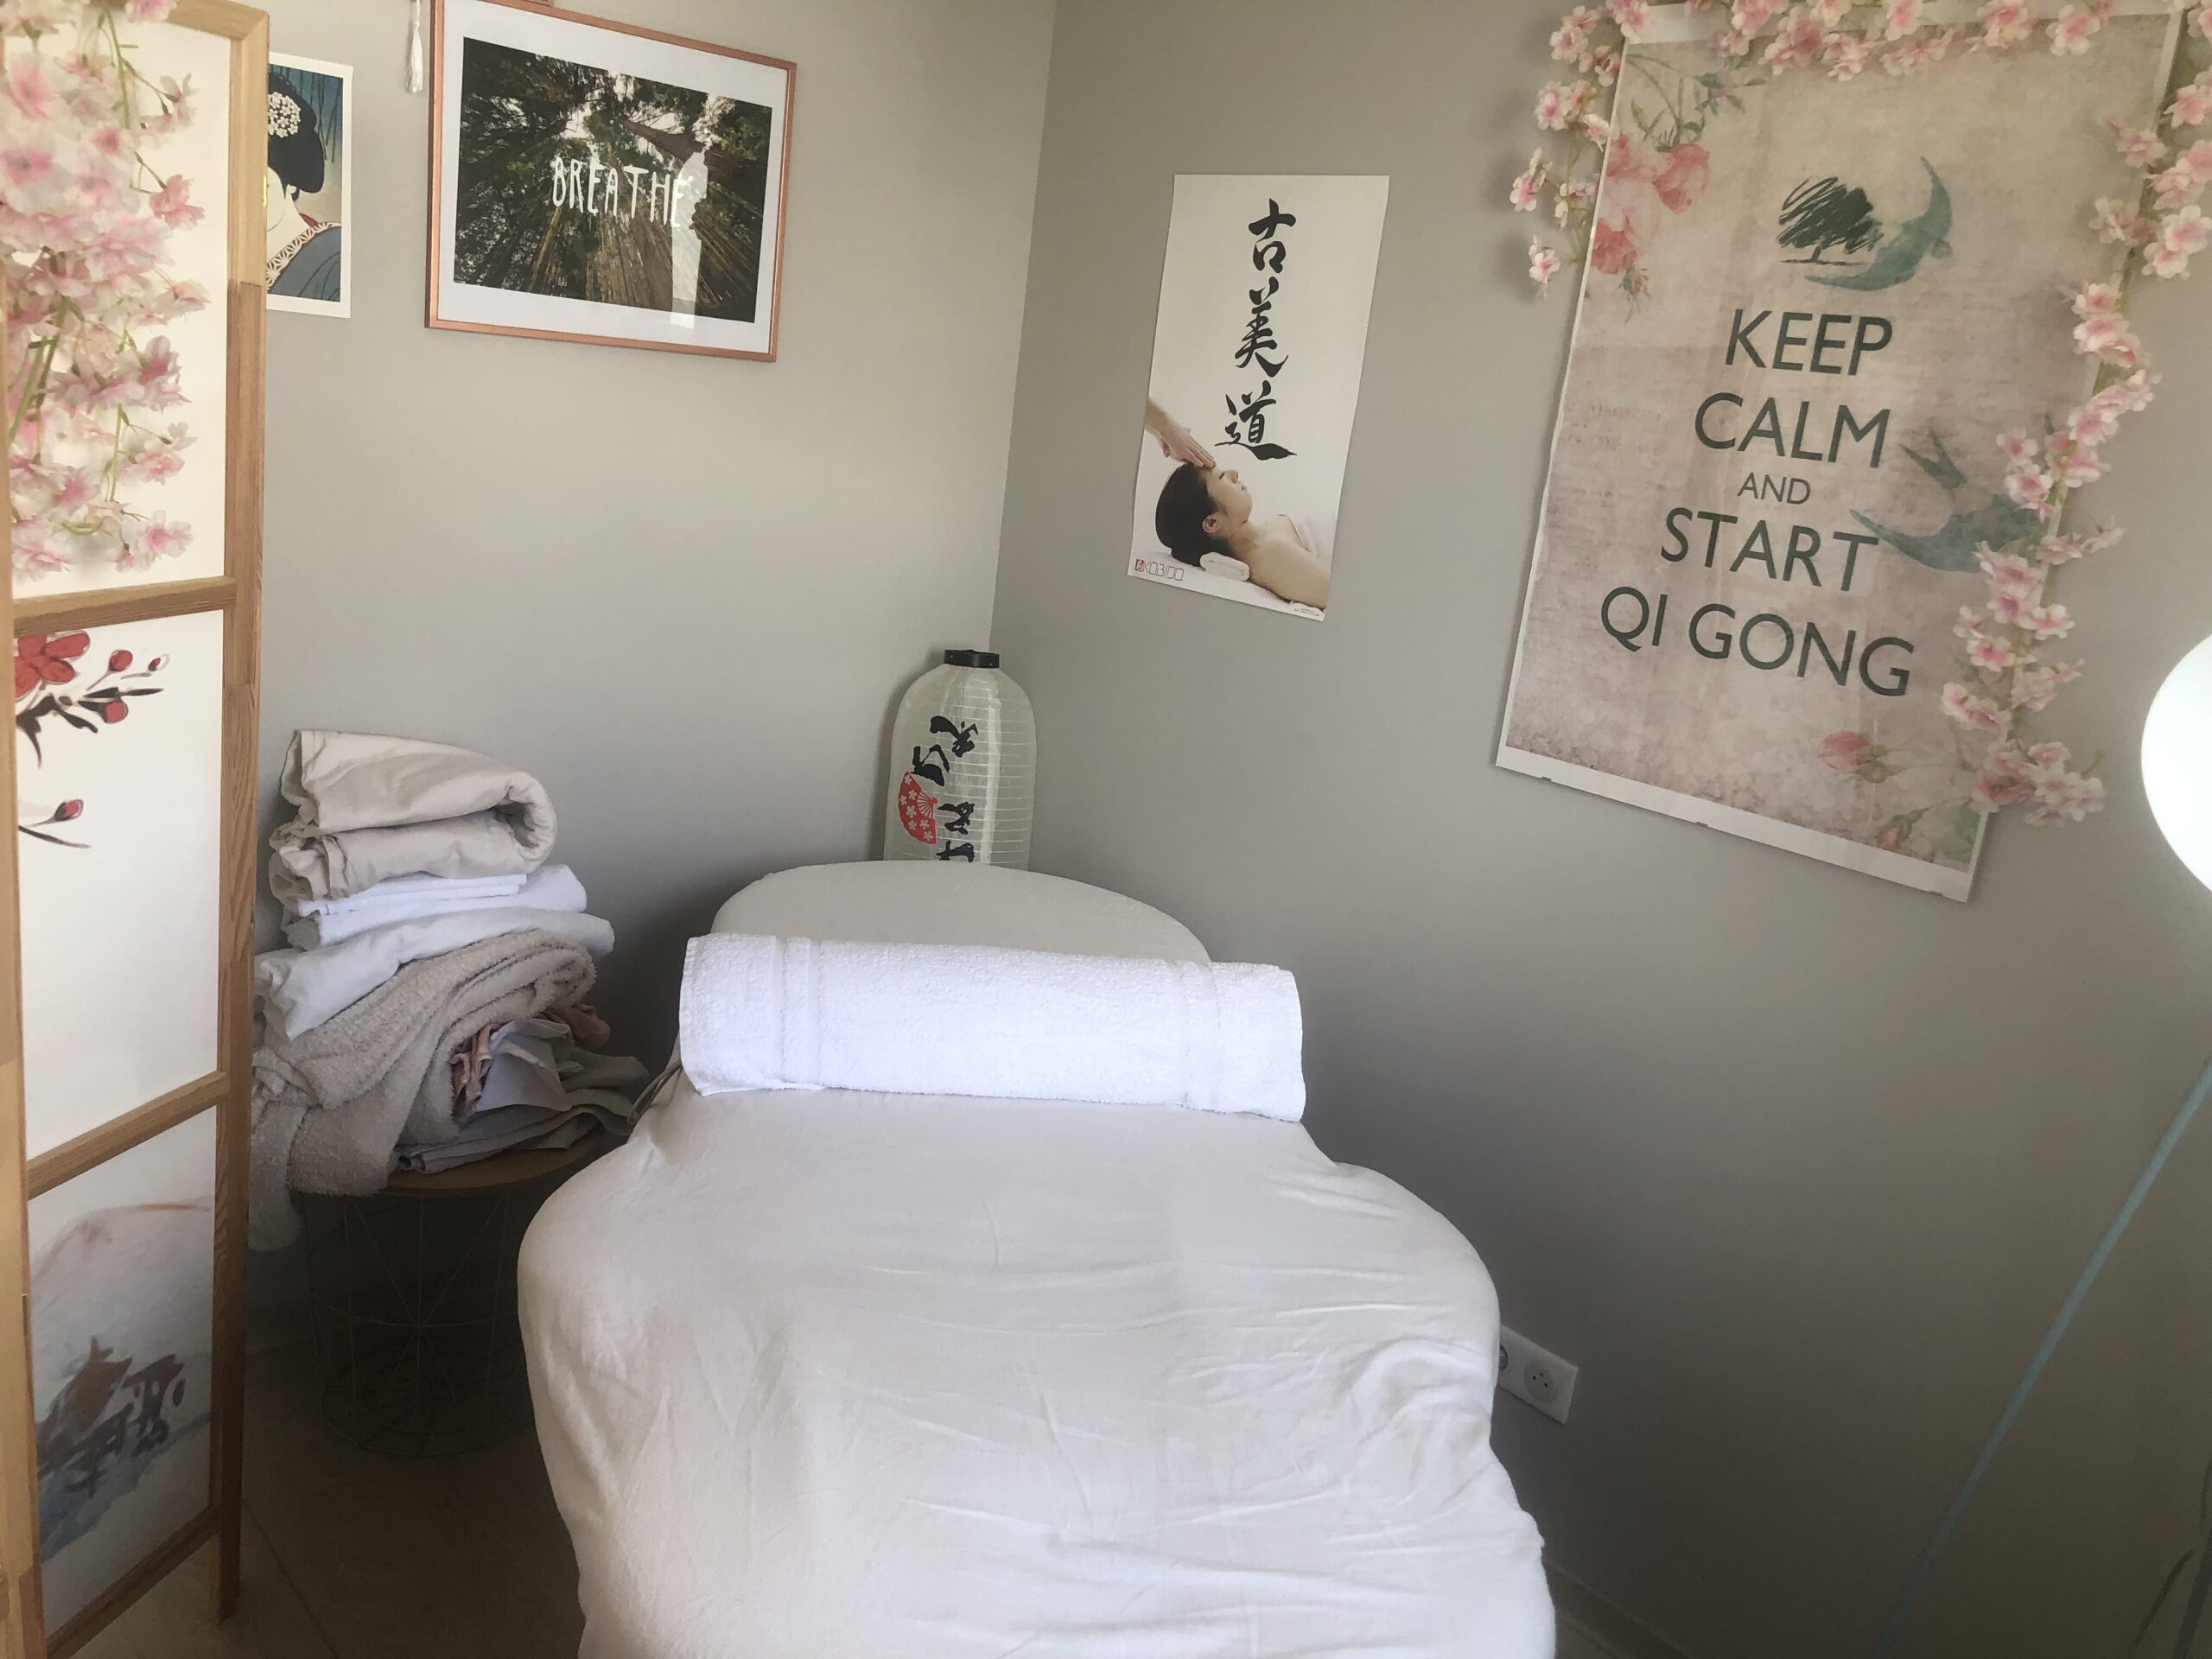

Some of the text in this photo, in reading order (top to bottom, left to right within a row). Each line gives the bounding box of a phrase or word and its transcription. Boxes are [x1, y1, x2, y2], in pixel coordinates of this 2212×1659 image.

[552, 156, 690, 227] BREATHE
[1726, 308, 1893, 376] KEEP
[1694, 392, 1891, 468] CALM
[1737, 473, 1811, 505] AND
[1660, 507, 1879, 592] START
[1600, 586, 1915, 697] QI GONG
